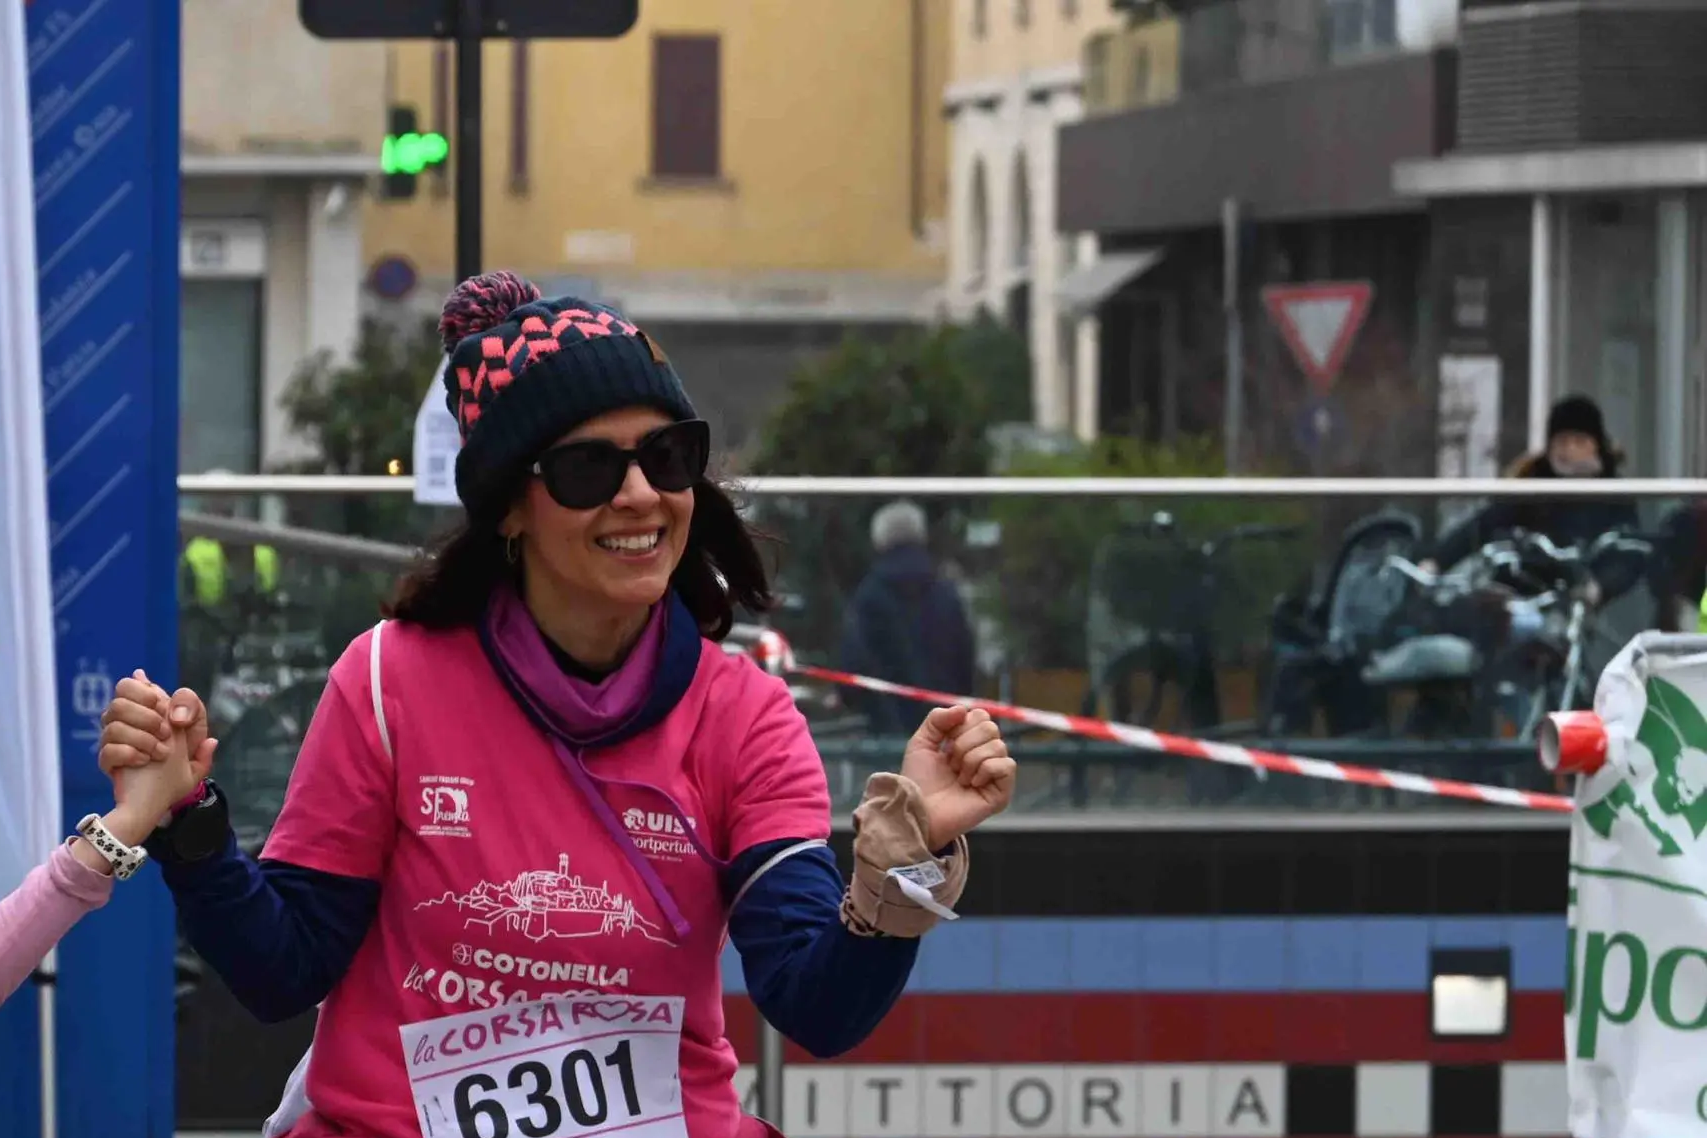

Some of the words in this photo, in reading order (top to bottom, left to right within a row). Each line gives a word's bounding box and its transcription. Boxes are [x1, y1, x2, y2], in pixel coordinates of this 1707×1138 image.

[473, 948, 628, 987] COTONELLA
[412, 1034, 436, 1066] la
[439, 1002, 564, 1056] CORSA
[572, 999, 674, 1026] ROSA
